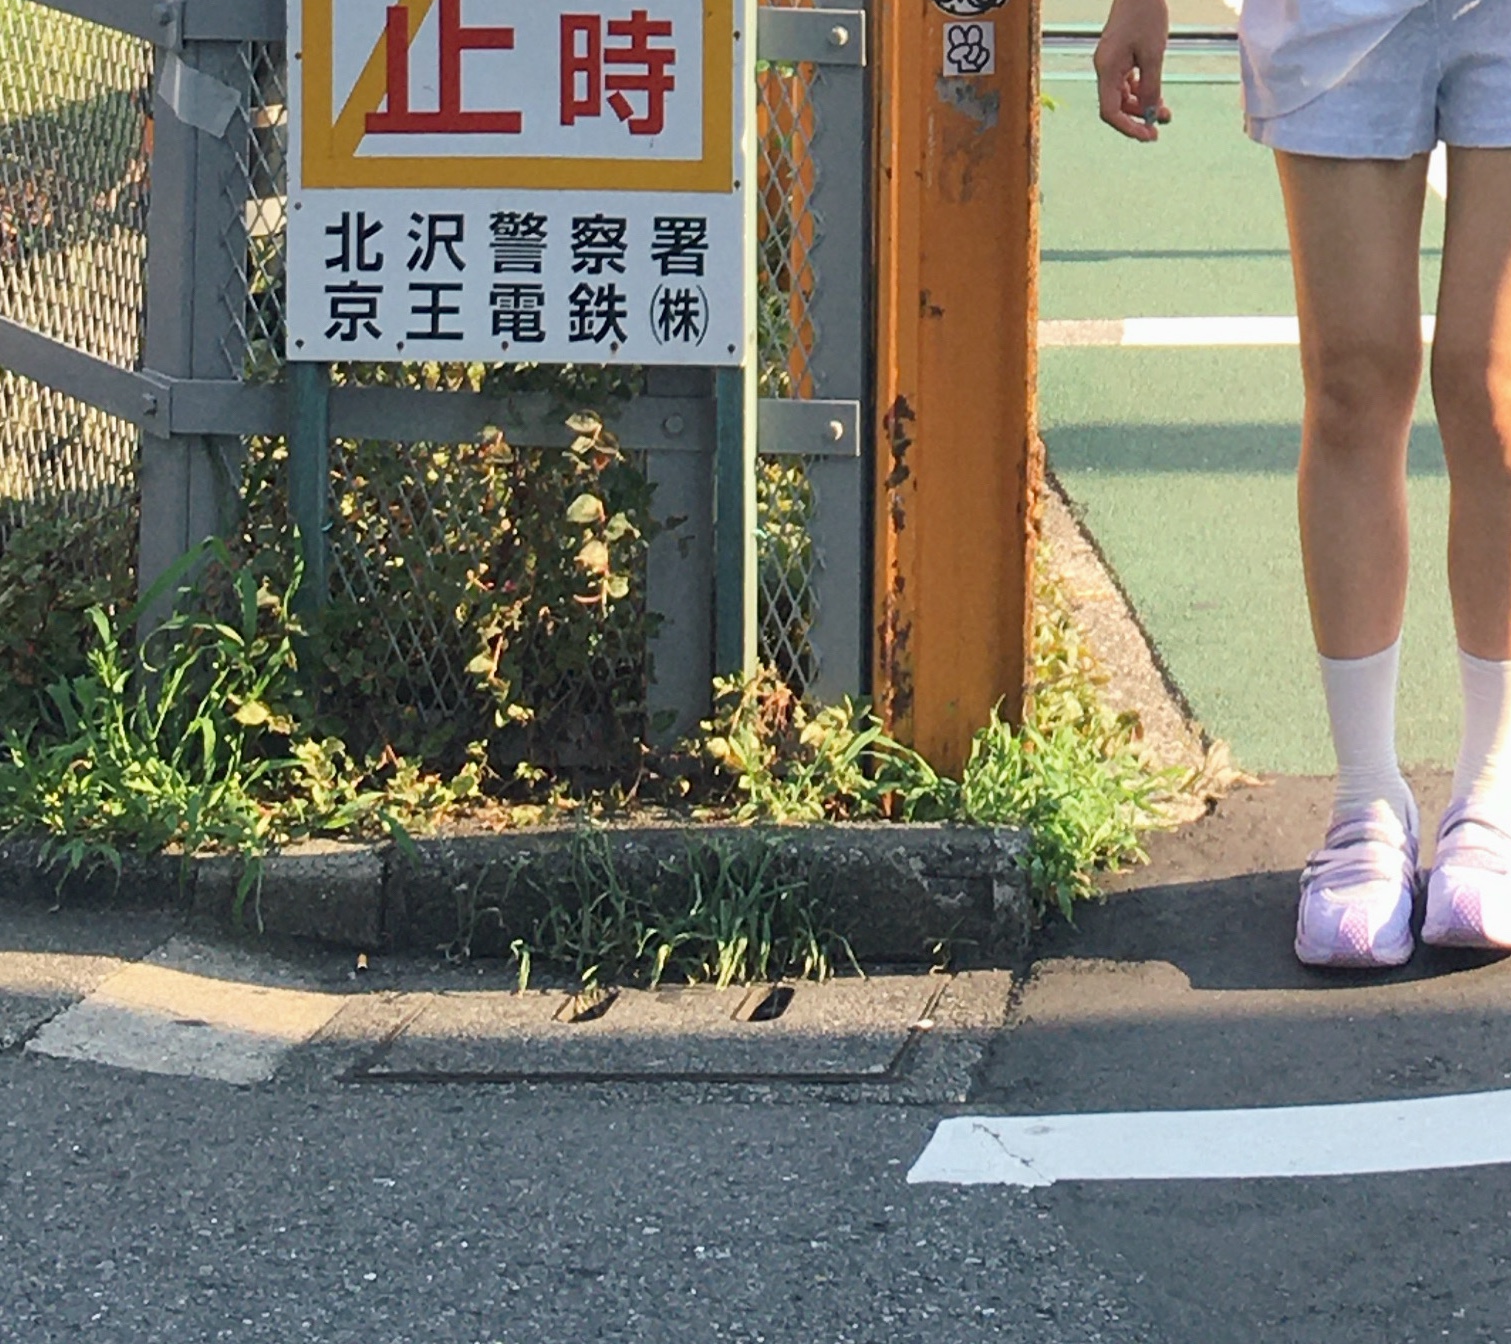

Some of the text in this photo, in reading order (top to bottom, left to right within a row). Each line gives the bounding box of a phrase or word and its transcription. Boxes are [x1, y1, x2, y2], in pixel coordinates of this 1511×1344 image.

[324, 211, 709, 277] 北沢警察署
